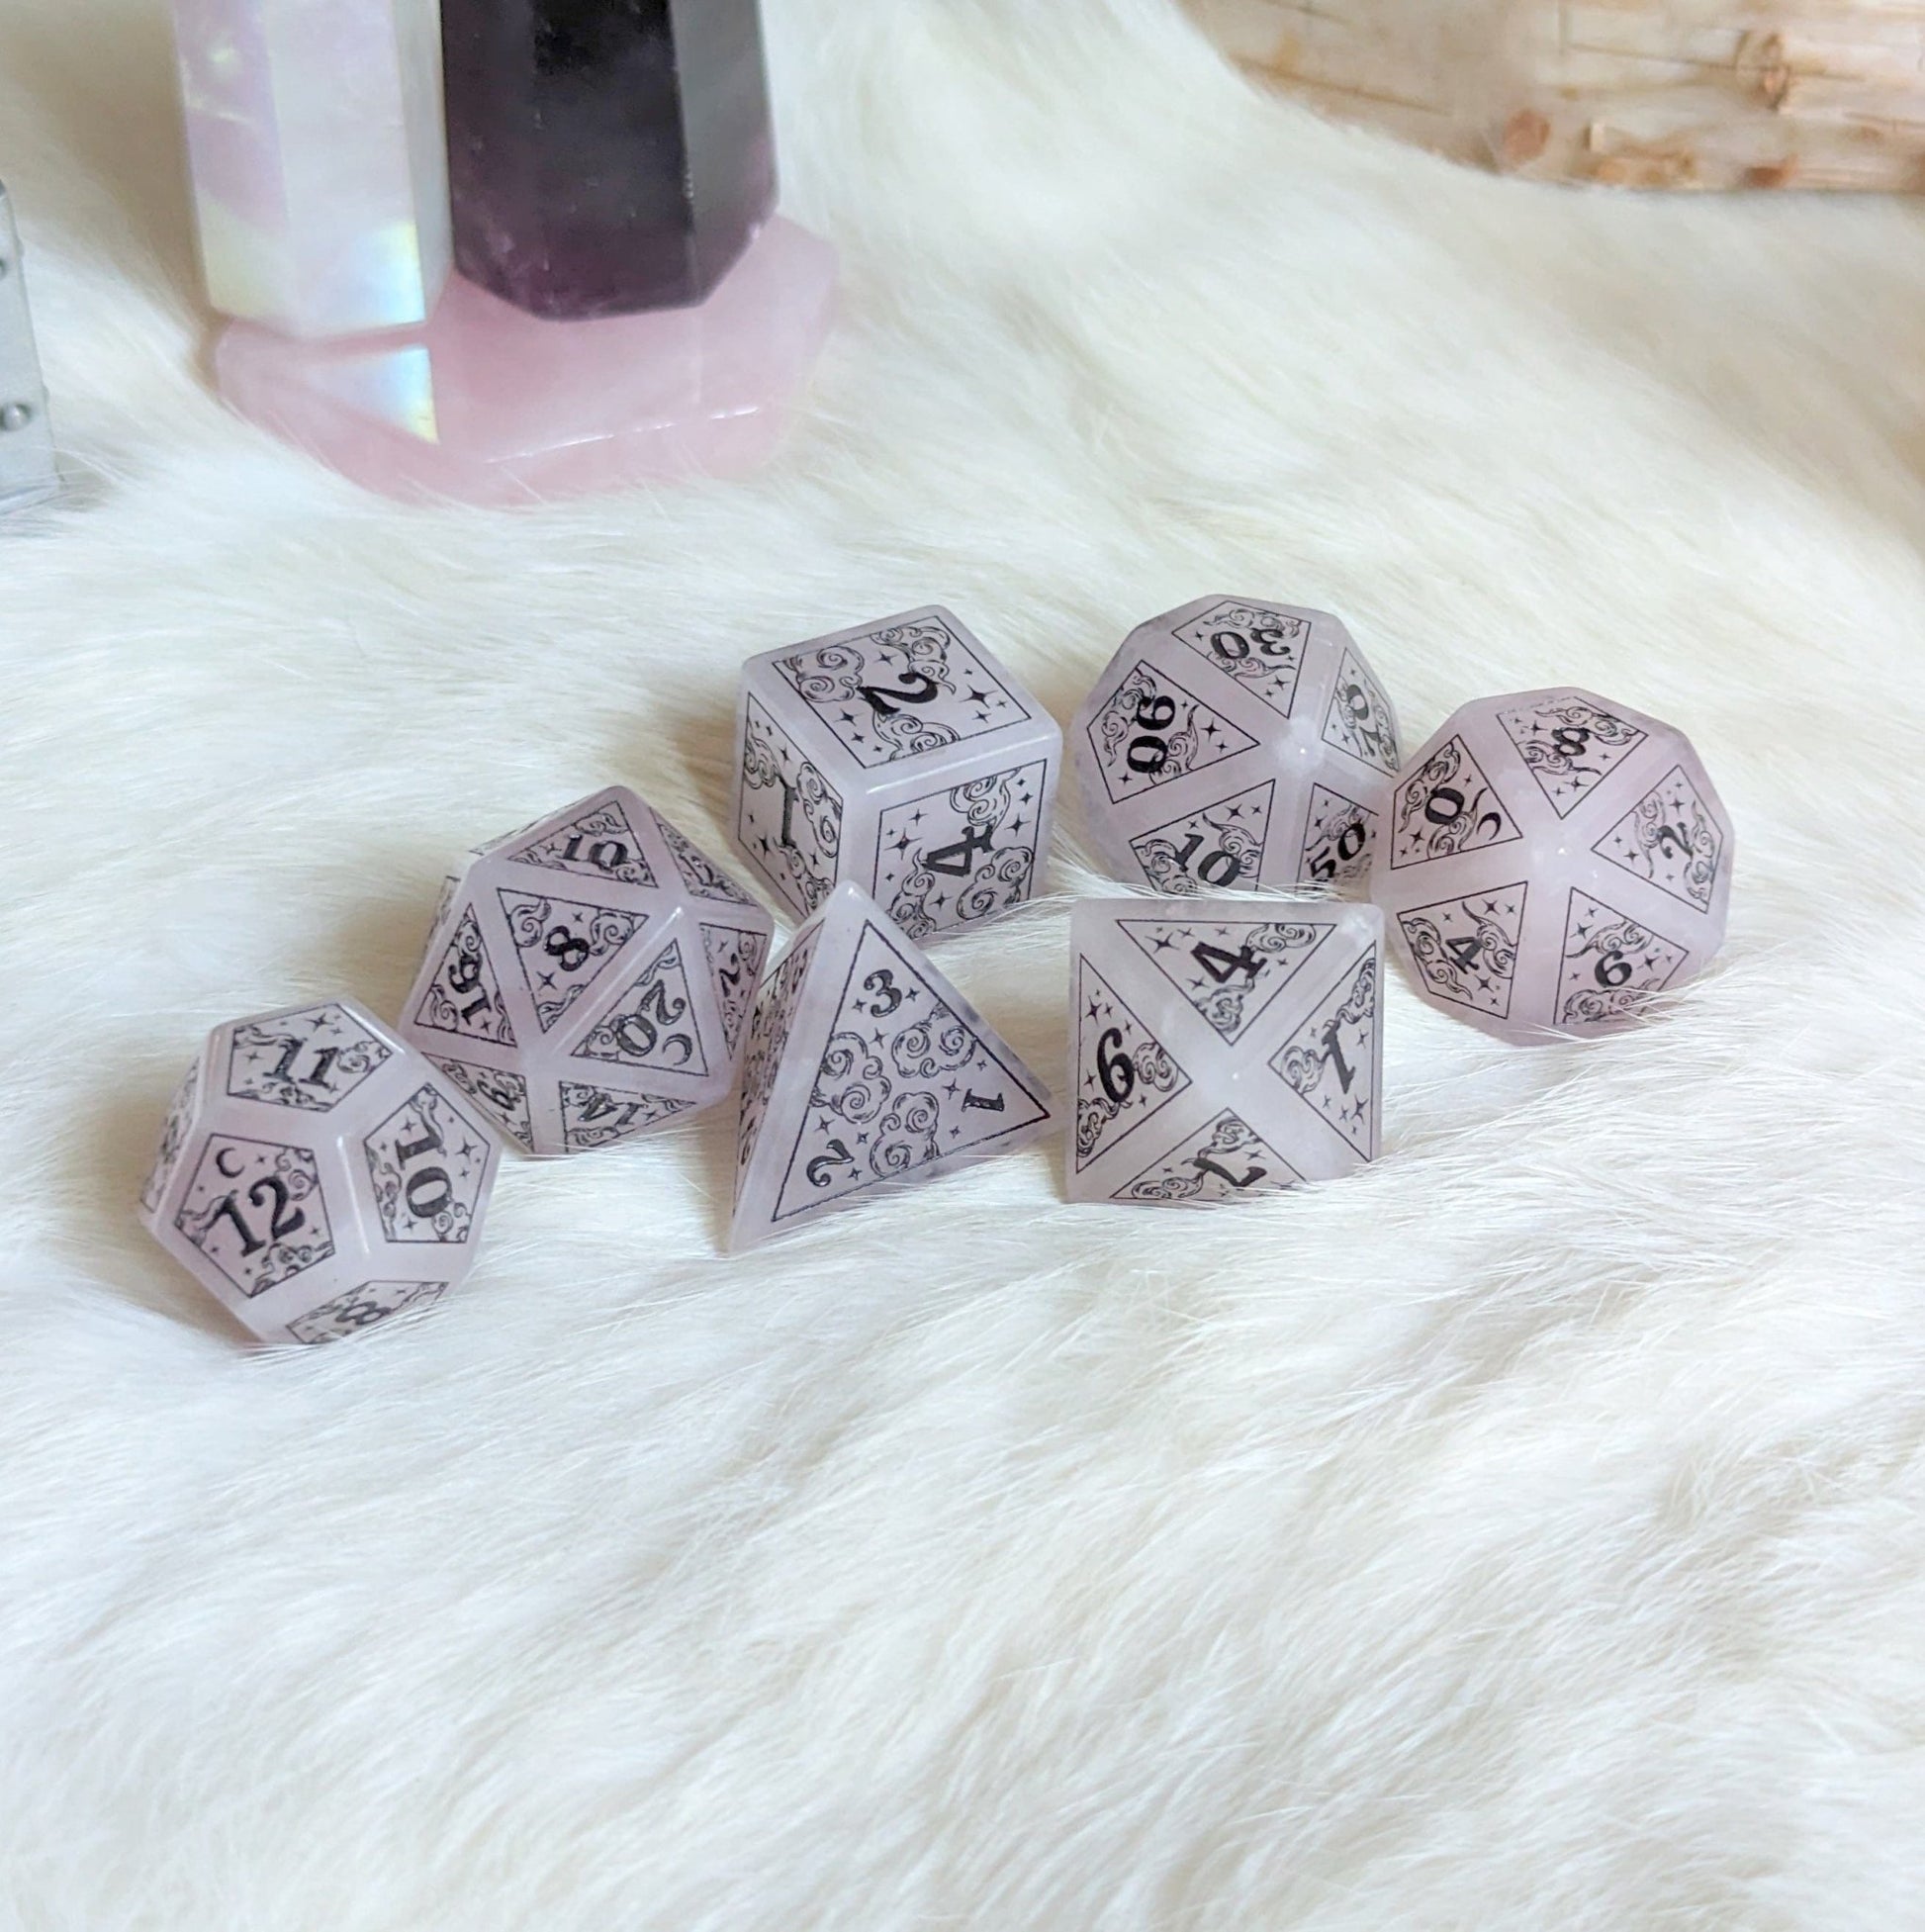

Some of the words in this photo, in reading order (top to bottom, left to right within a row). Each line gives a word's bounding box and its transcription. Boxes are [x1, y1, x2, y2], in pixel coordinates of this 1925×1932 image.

[1210, 628, 1291, 660] 30
[856, 672, 939, 716] 2
[1127, 695, 1176, 774] 90
[1551, 726, 1591, 757] 8
[775, 777, 797, 848] 1
[1424, 787, 1465, 825] 0
[561, 833, 629, 872] 10
[924, 823, 995, 878] 4
[1174, 833, 1240, 888] 10
[1310, 822, 1366, 883] 50
[1658, 822, 1693, 859] 2
[544, 925, 590, 971] 8
[1191, 941, 1267, 983] 4
[1445, 935, 1484, 974] 4
[1595, 950, 1632, 988] 6
[448, 952, 492, 1025] 16
[718, 952, 741, 997] 2
[864, 968, 903, 1017] 3
[615, 979, 687, 1057] 20
[263, 1038, 339, 1088] 11
[1097, 1027, 1135, 1103] 6
[1321, 1024, 1356, 1094] 1
[578, 1091, 644, 1126] 14
[961, 1088, 1006, 1112] 1
[396, 1135, 453, 1219] 10
[806, 1139, 854, 1187] 2
[1192, 1157, 1267, 1188] 7
[202, 1175, 306, 1257] 12
[334, 1301, 392, 1327] 8
